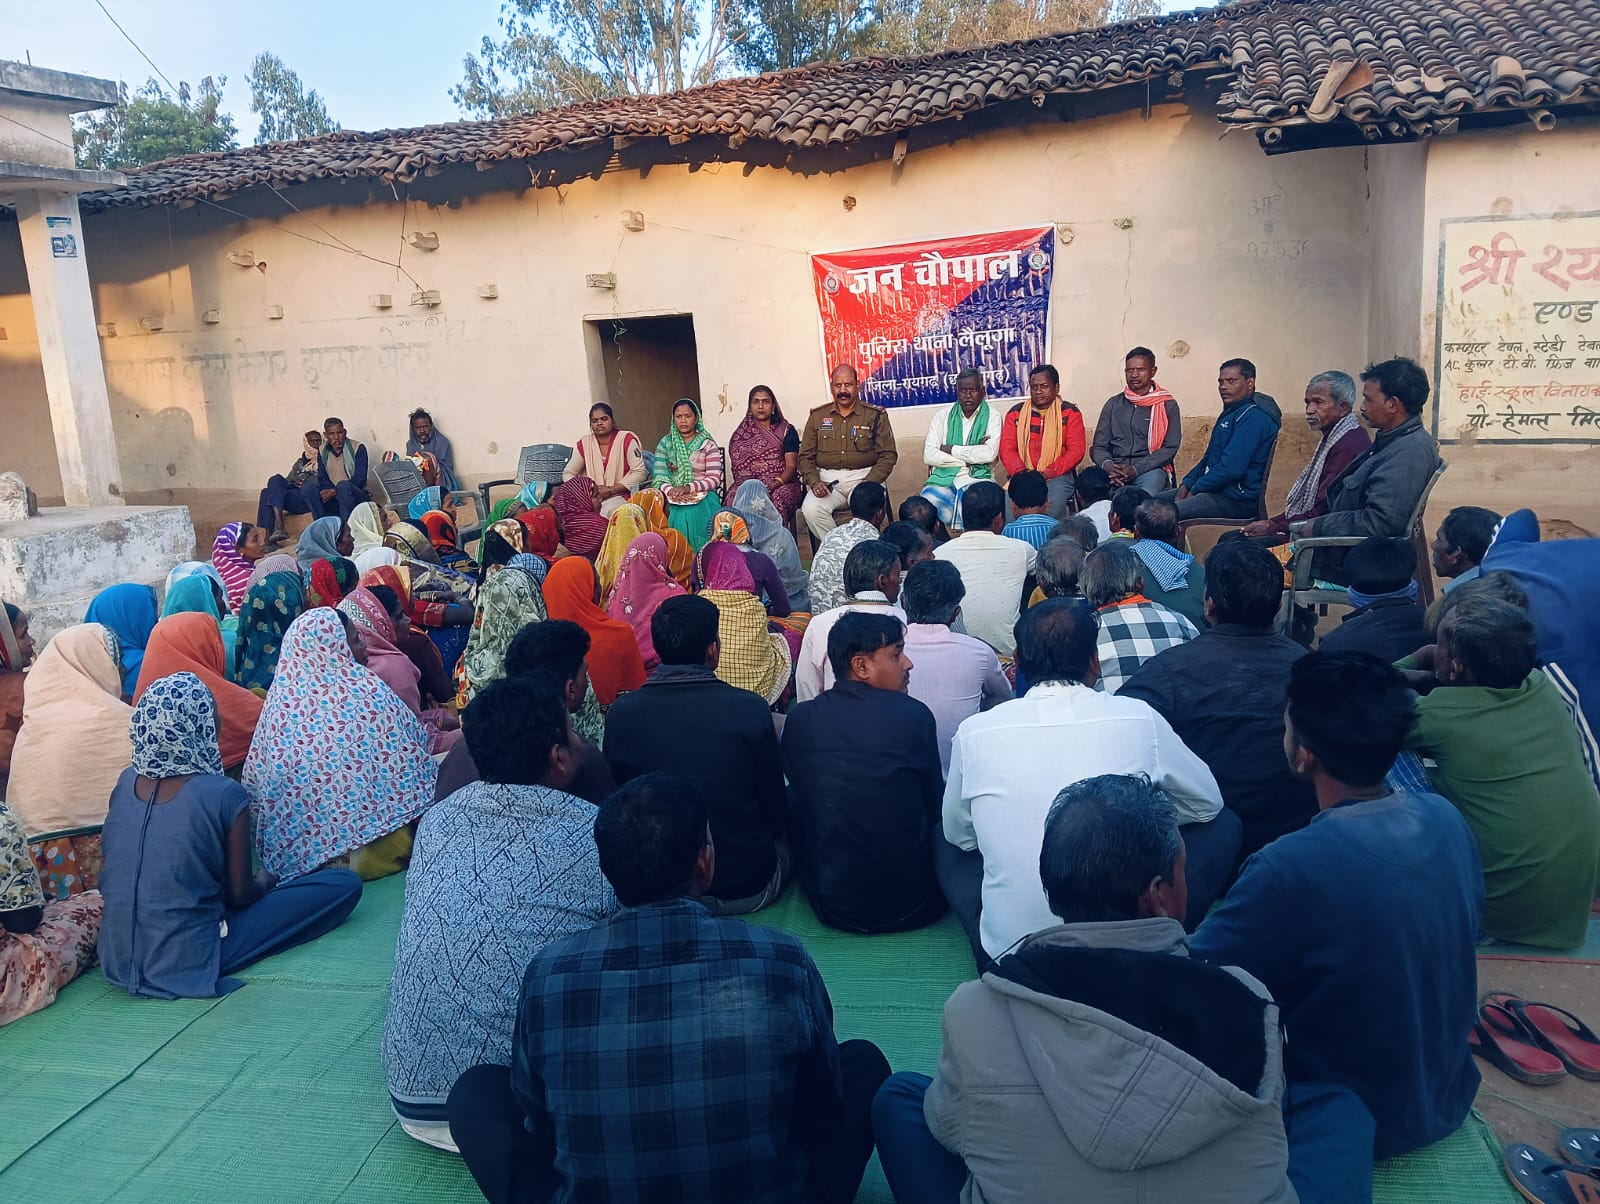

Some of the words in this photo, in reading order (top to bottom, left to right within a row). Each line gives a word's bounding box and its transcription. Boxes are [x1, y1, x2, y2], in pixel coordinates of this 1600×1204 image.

[847, 263, 904, 295] जन
[912, 250, 1022, 287] चौपाल
[1459, 232, 1526, 293] श्री
[858, 336, 908, 364] पुलिस
[913, 333, 953, 352] थाना
